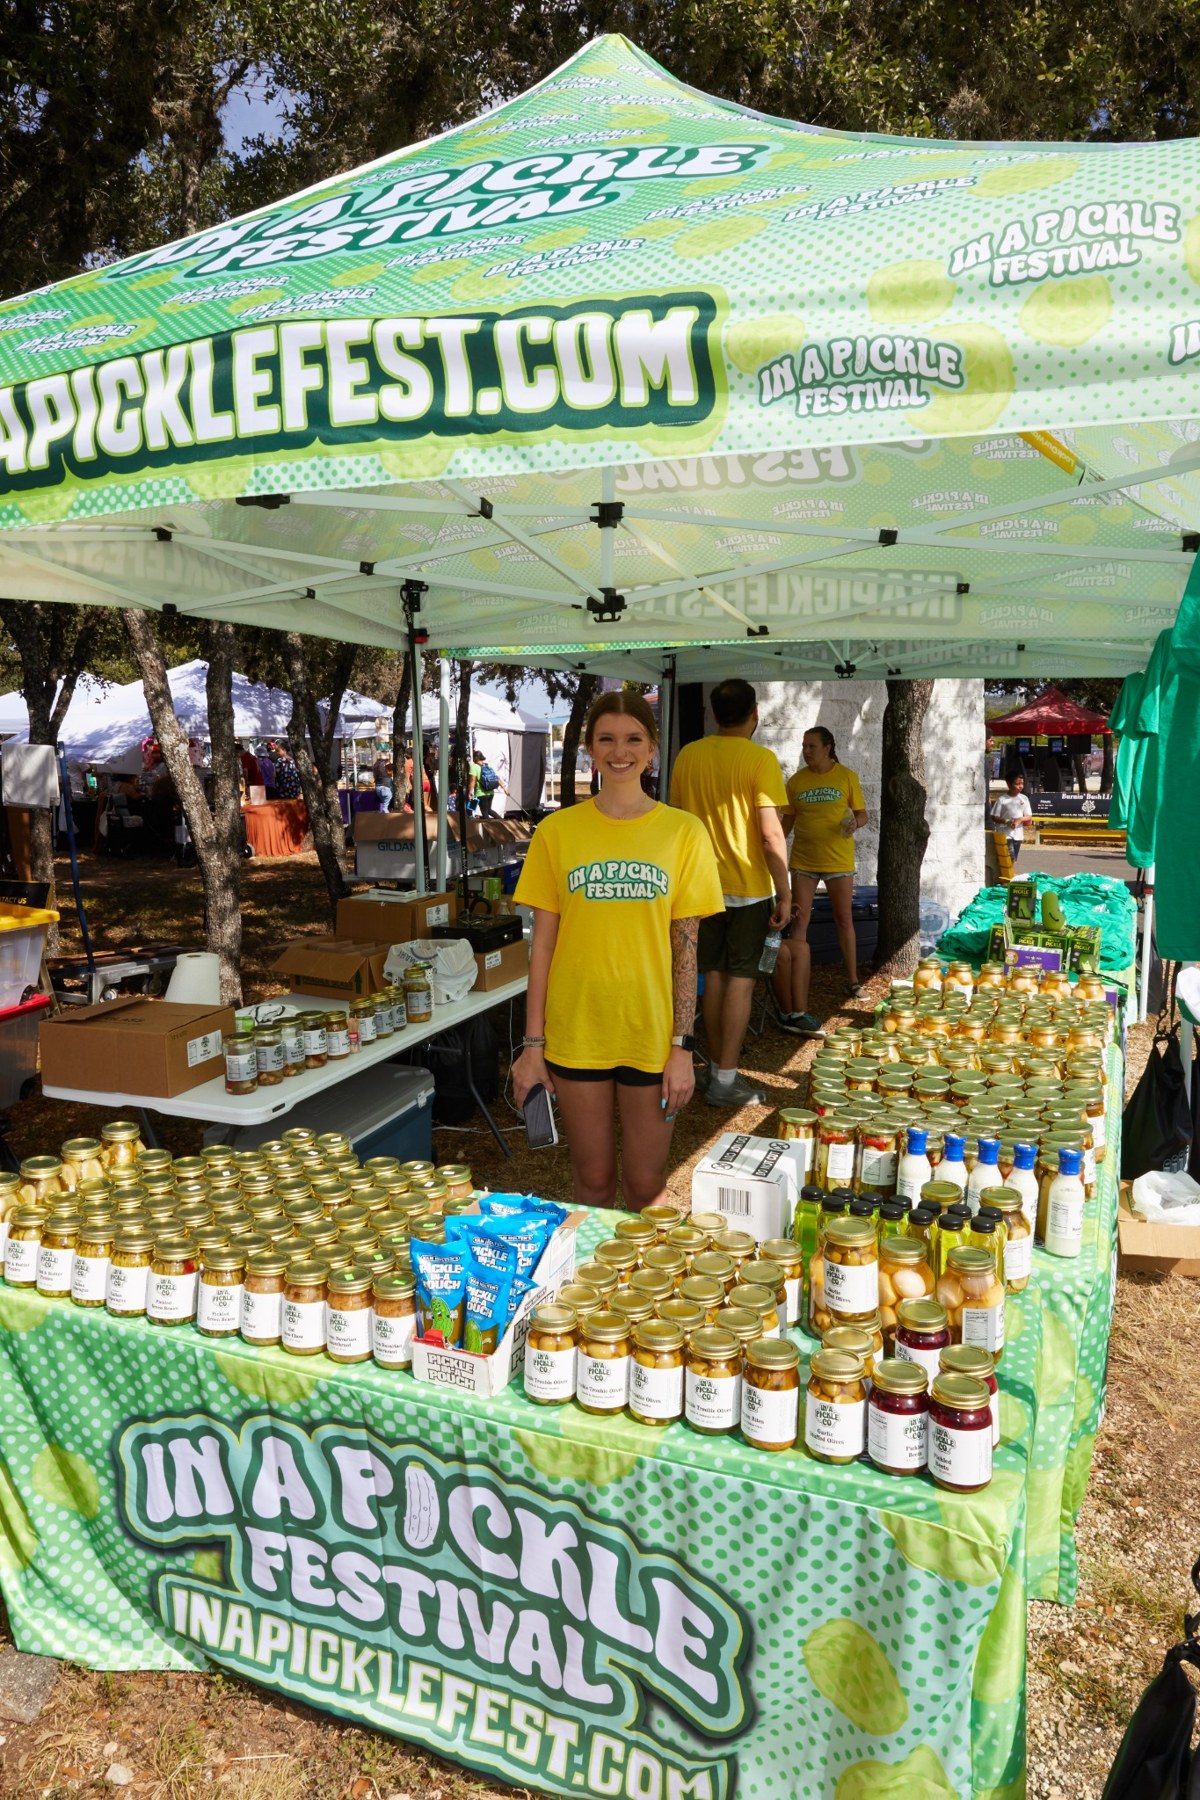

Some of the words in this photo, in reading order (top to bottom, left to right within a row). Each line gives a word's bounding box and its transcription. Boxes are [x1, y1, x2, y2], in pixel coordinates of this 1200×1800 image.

[782, 203, 822, 222] IN
[822, 195, 854, 210] A
[853, 176, 978, 202] PICKLE
[814, 188, 944, 220] FESTIVAL
[114, 214, 277, 277] IN
[262, 195, 355, 239] A
[360, 146, 758, 214] PICKLE
[196, 183, 608, 274] FESTIVAL
[950, 233, 993, 275] IN
[999, 222, 1027, 254] A
[1034, 202, 1179, 245] PICKLE
[483, 261, 519, 278] IN
[518, 252, 546, 267] A
[544, 237, 646, 260] PICKLE
[506, 250, 611, 278] FESTIVAL
[990, 238, 1140, 284] FESTIVAL
[760, 357, 797, 404] IN
[801, 346, 827, 385] A
[829, 336, 962, 385] PICKLE
[797, 378, 928, 416] FESTIVAL
[377, 841, 416, 852] GILDAN
[569, 866, 586, 892] IN
[589, 863, 603, 881] A
[605, 861, 668, 894] PICKLE
[586, 882, 656, 898] FESTIVAL
[471, 1246, 508, 1262] PICKLE
[419, 1264, 462, 1274] PICKLE
[423, 1280, 462, 1290] POUCH
[466, 1285, 497, 1304] PICKLE
[467, 1302, 493, 1318] OUCH
[427, 1352, 475, 1375] PICKLE
[533, 1359, 554, 1368] PICKLE
[588, 1368, 611, 1376] PICKLE
[427, 1368, 476, 1391] POUCH
[695, 1387, 718, 1395] PICKLE
[816, 1411, 839, 1421] PICKLE
[822, 1418, 832, 1426] CO
[903, 1424, 926, 1436] PICKLE
[934, 1434, 955, 1447] PICKLE
[938, 1442, 947, 1452] CO
[141, 1435, 235, 1523] IN
[252, 1435, 317, 1520] A
[331, 1445, 719, 1704] PICKLE
[244, 1526, 614, 1704] FESTIVAL
[171, 1587, 713, 1800] INAPICKLEFEST.COM
